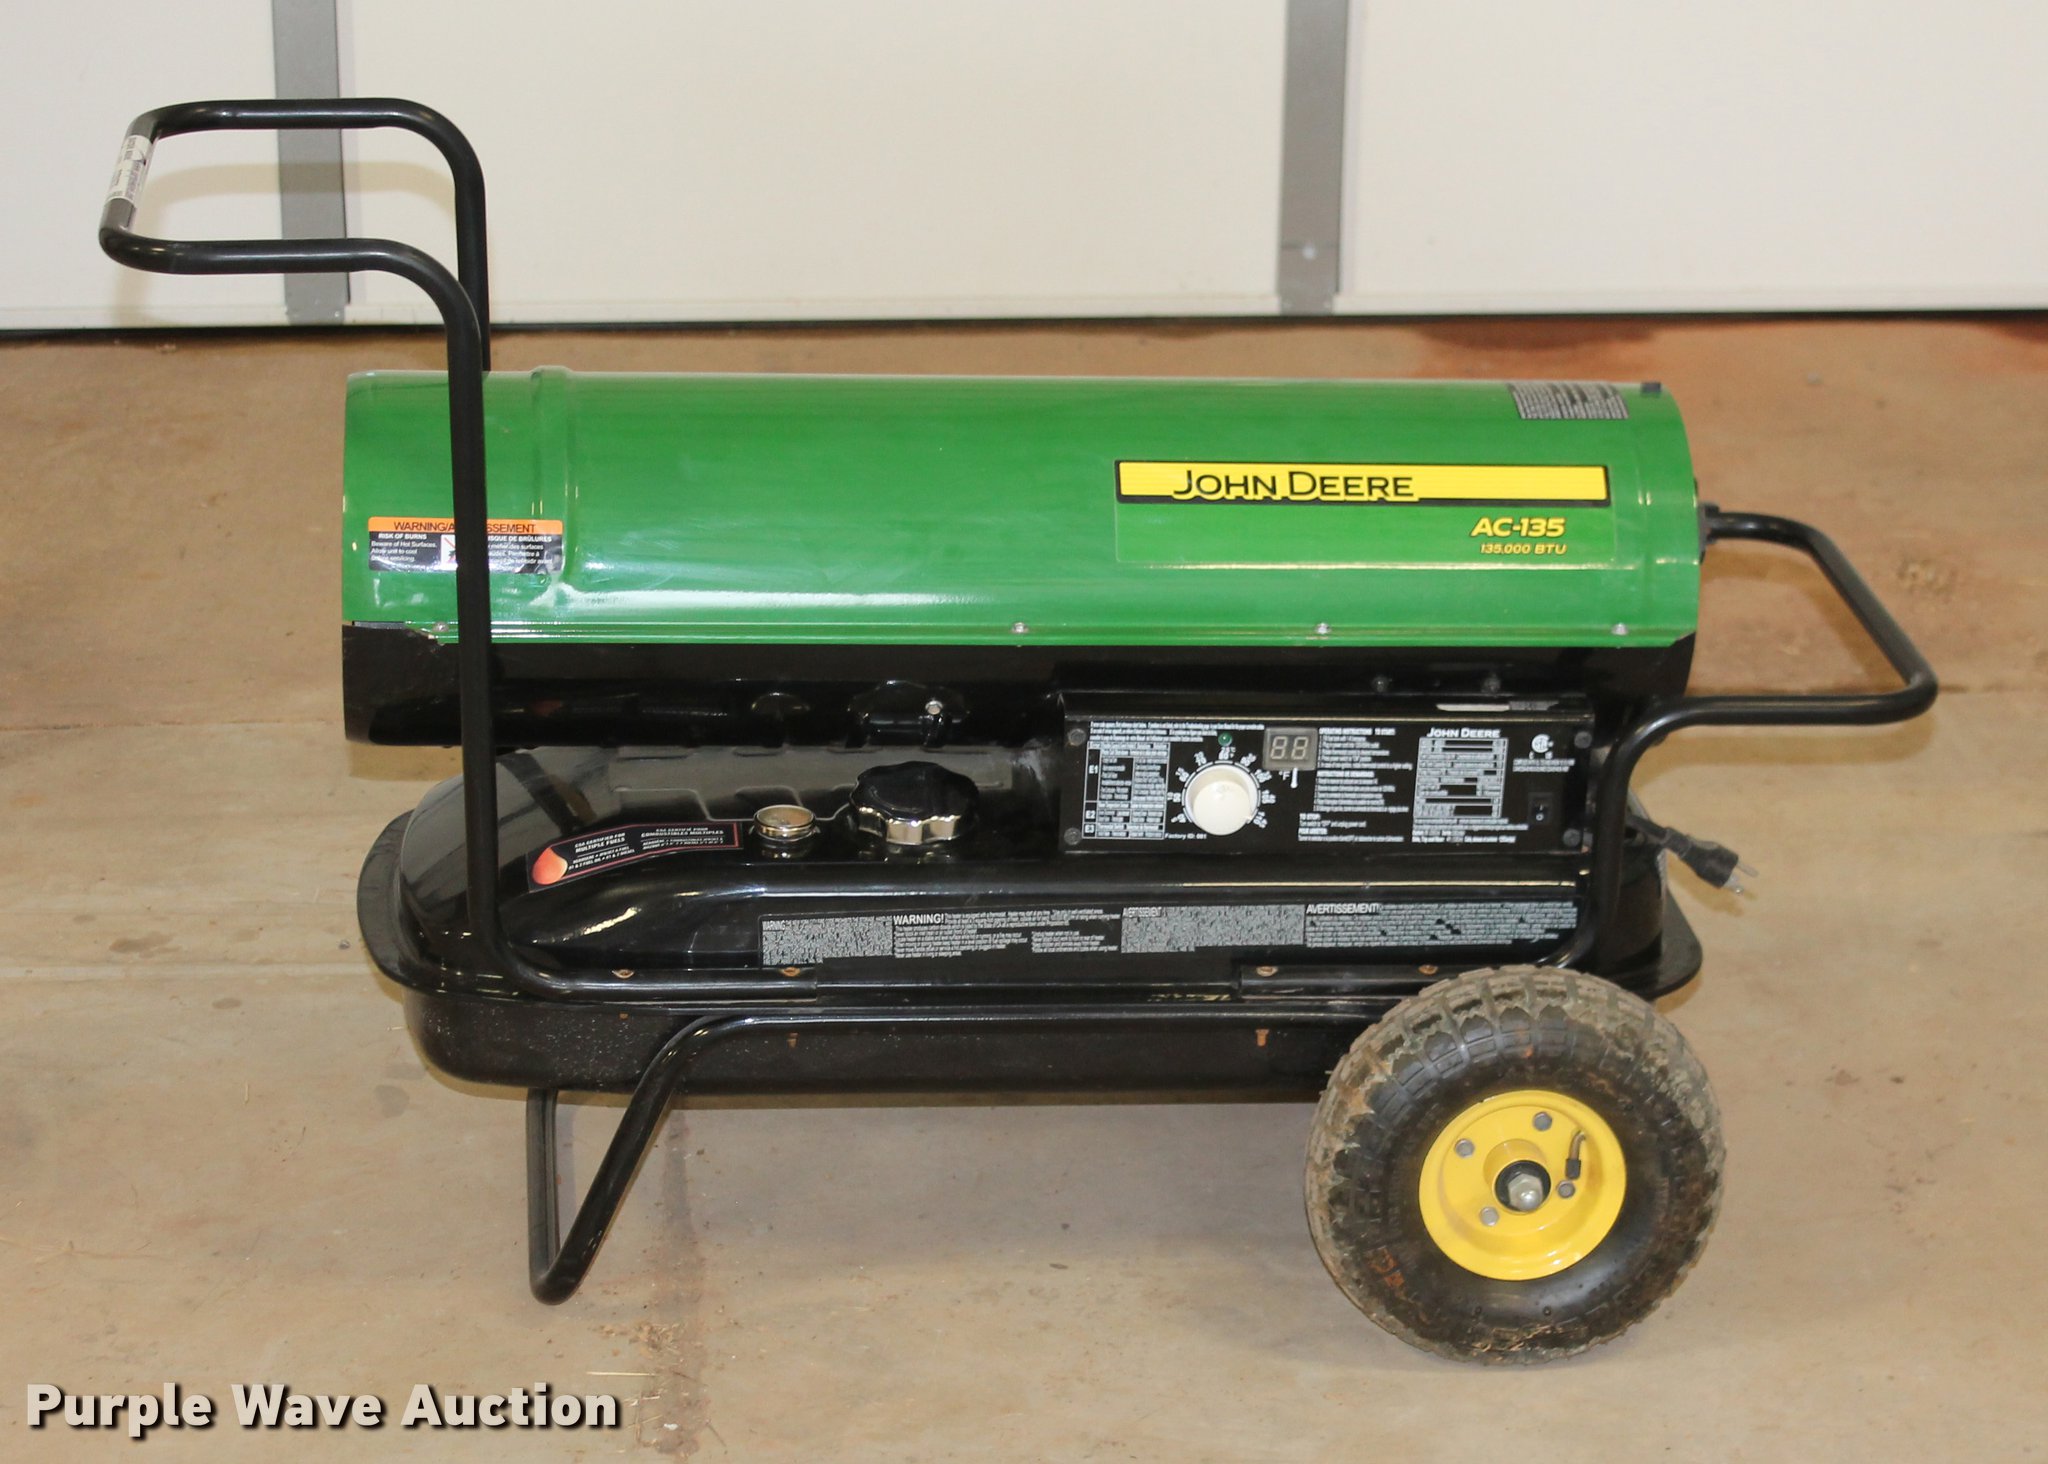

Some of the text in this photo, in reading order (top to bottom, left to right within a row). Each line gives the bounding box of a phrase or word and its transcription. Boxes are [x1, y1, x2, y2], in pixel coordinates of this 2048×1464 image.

[1173, 470, 1414, 497] JOHN DEERE
[1470, 517, 1566, 537] AC-135
[1534, 543, 1567, 554] BTU
[1427, 727, 1500, 738] JOHN DEERE
[893, 914, 945, 925] WARNING!
